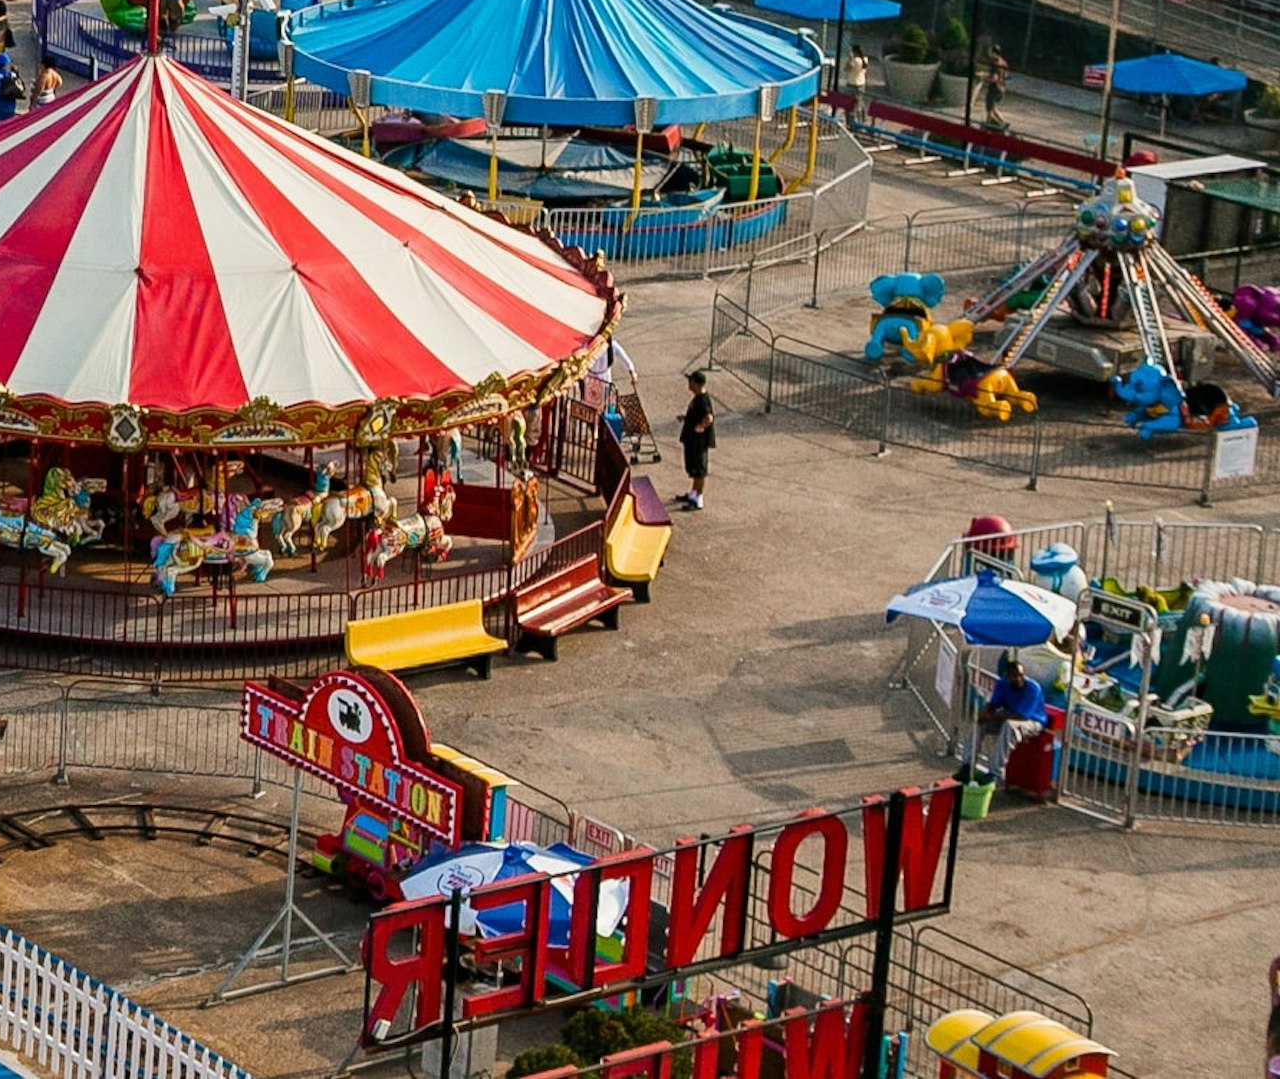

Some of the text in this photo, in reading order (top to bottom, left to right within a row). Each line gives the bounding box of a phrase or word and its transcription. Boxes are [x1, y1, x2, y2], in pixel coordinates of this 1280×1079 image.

[1101, 602, 1132, 620] EXIT
[1084, 712, 1119, 736] EXIT
[256, 704, 334, 770] TRAIN
[341, 746, 443, 825] STATION
[589, 824, 613, 846] EXIT
